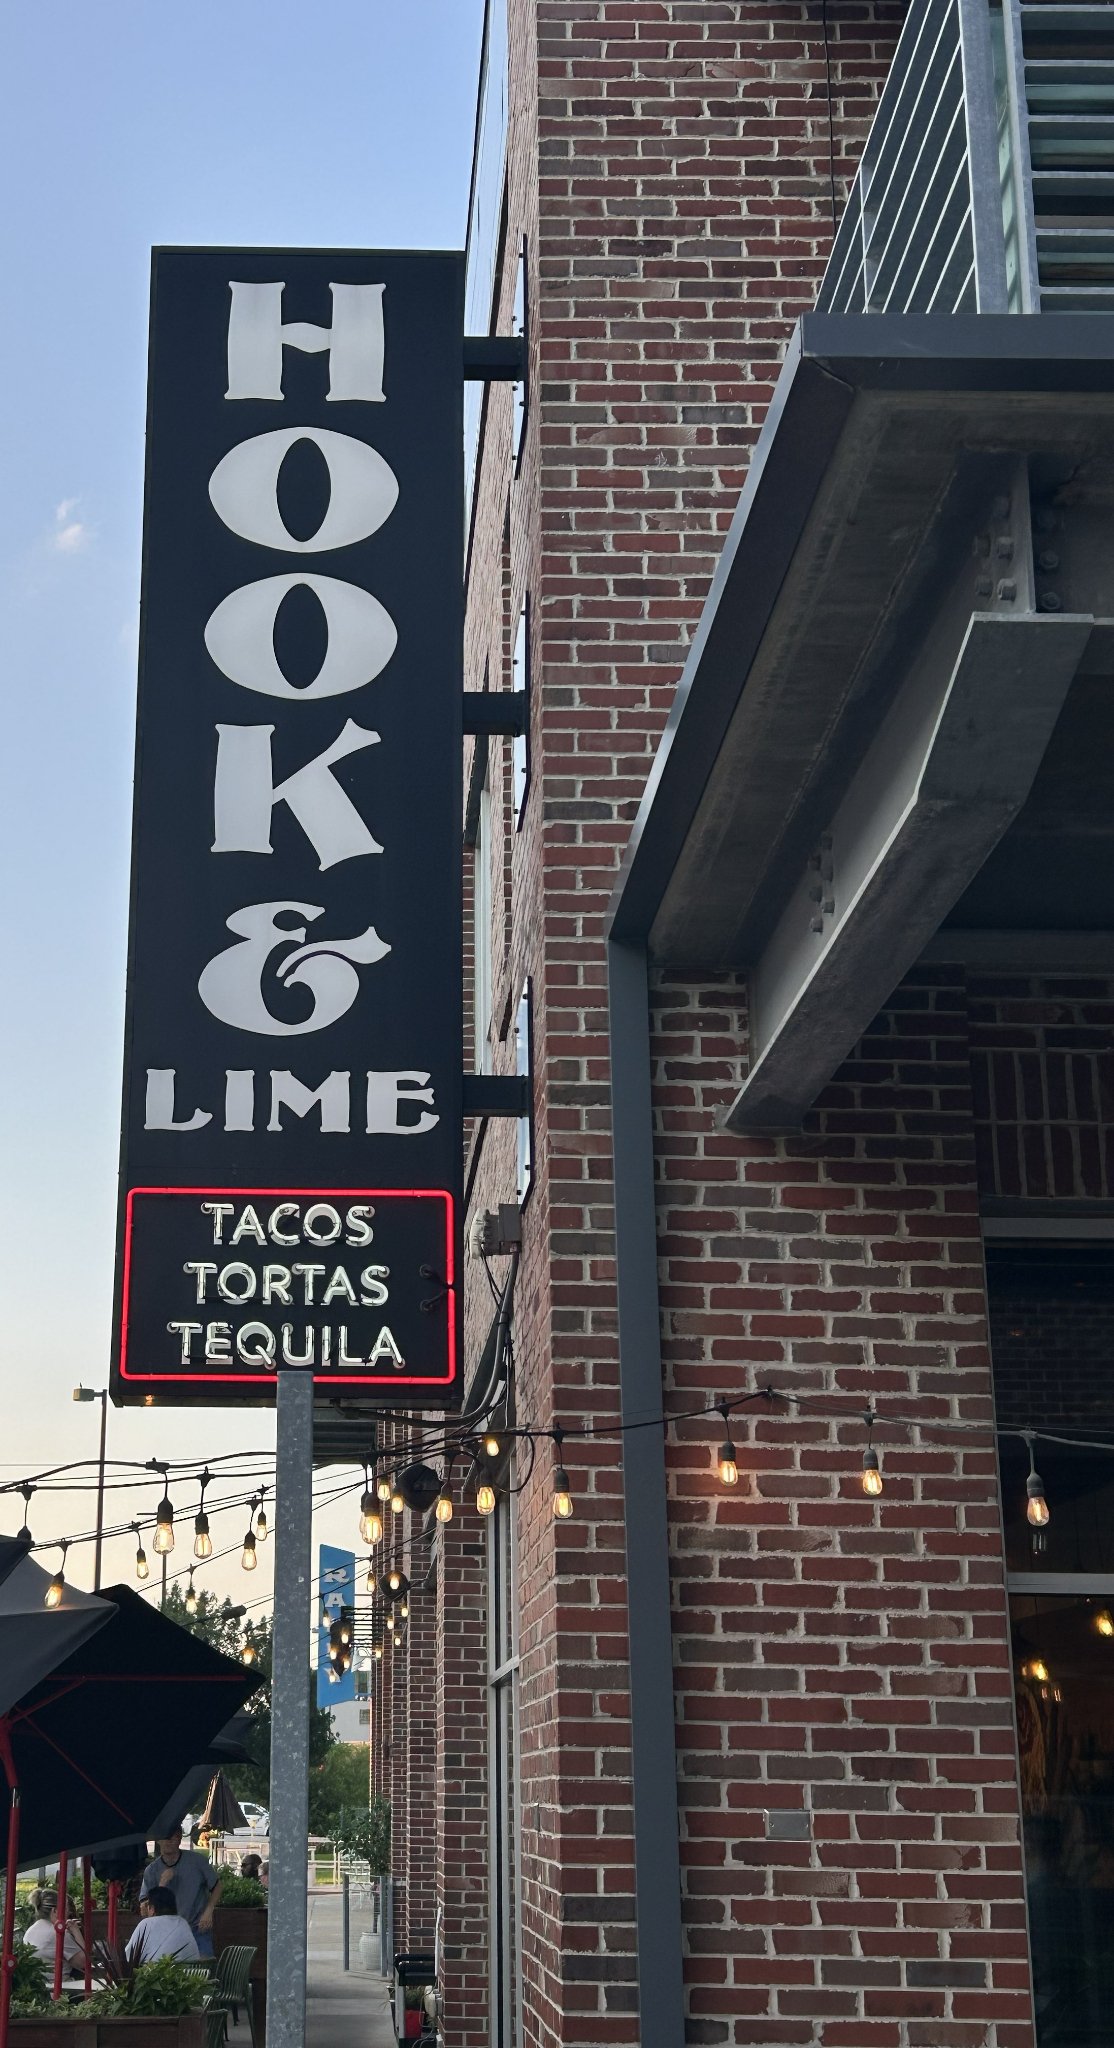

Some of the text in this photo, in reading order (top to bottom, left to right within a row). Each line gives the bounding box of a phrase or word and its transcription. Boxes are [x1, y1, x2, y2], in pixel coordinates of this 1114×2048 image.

[197, 280, 400, 1038] HOOK &
[144, 1069, 440, 1134] LIME
[202, 1202, 376, 1246] TACOS
[183, 1261, 390, 1306] TORTAS
[167, 1320, 406, 1369] TEQUILA
